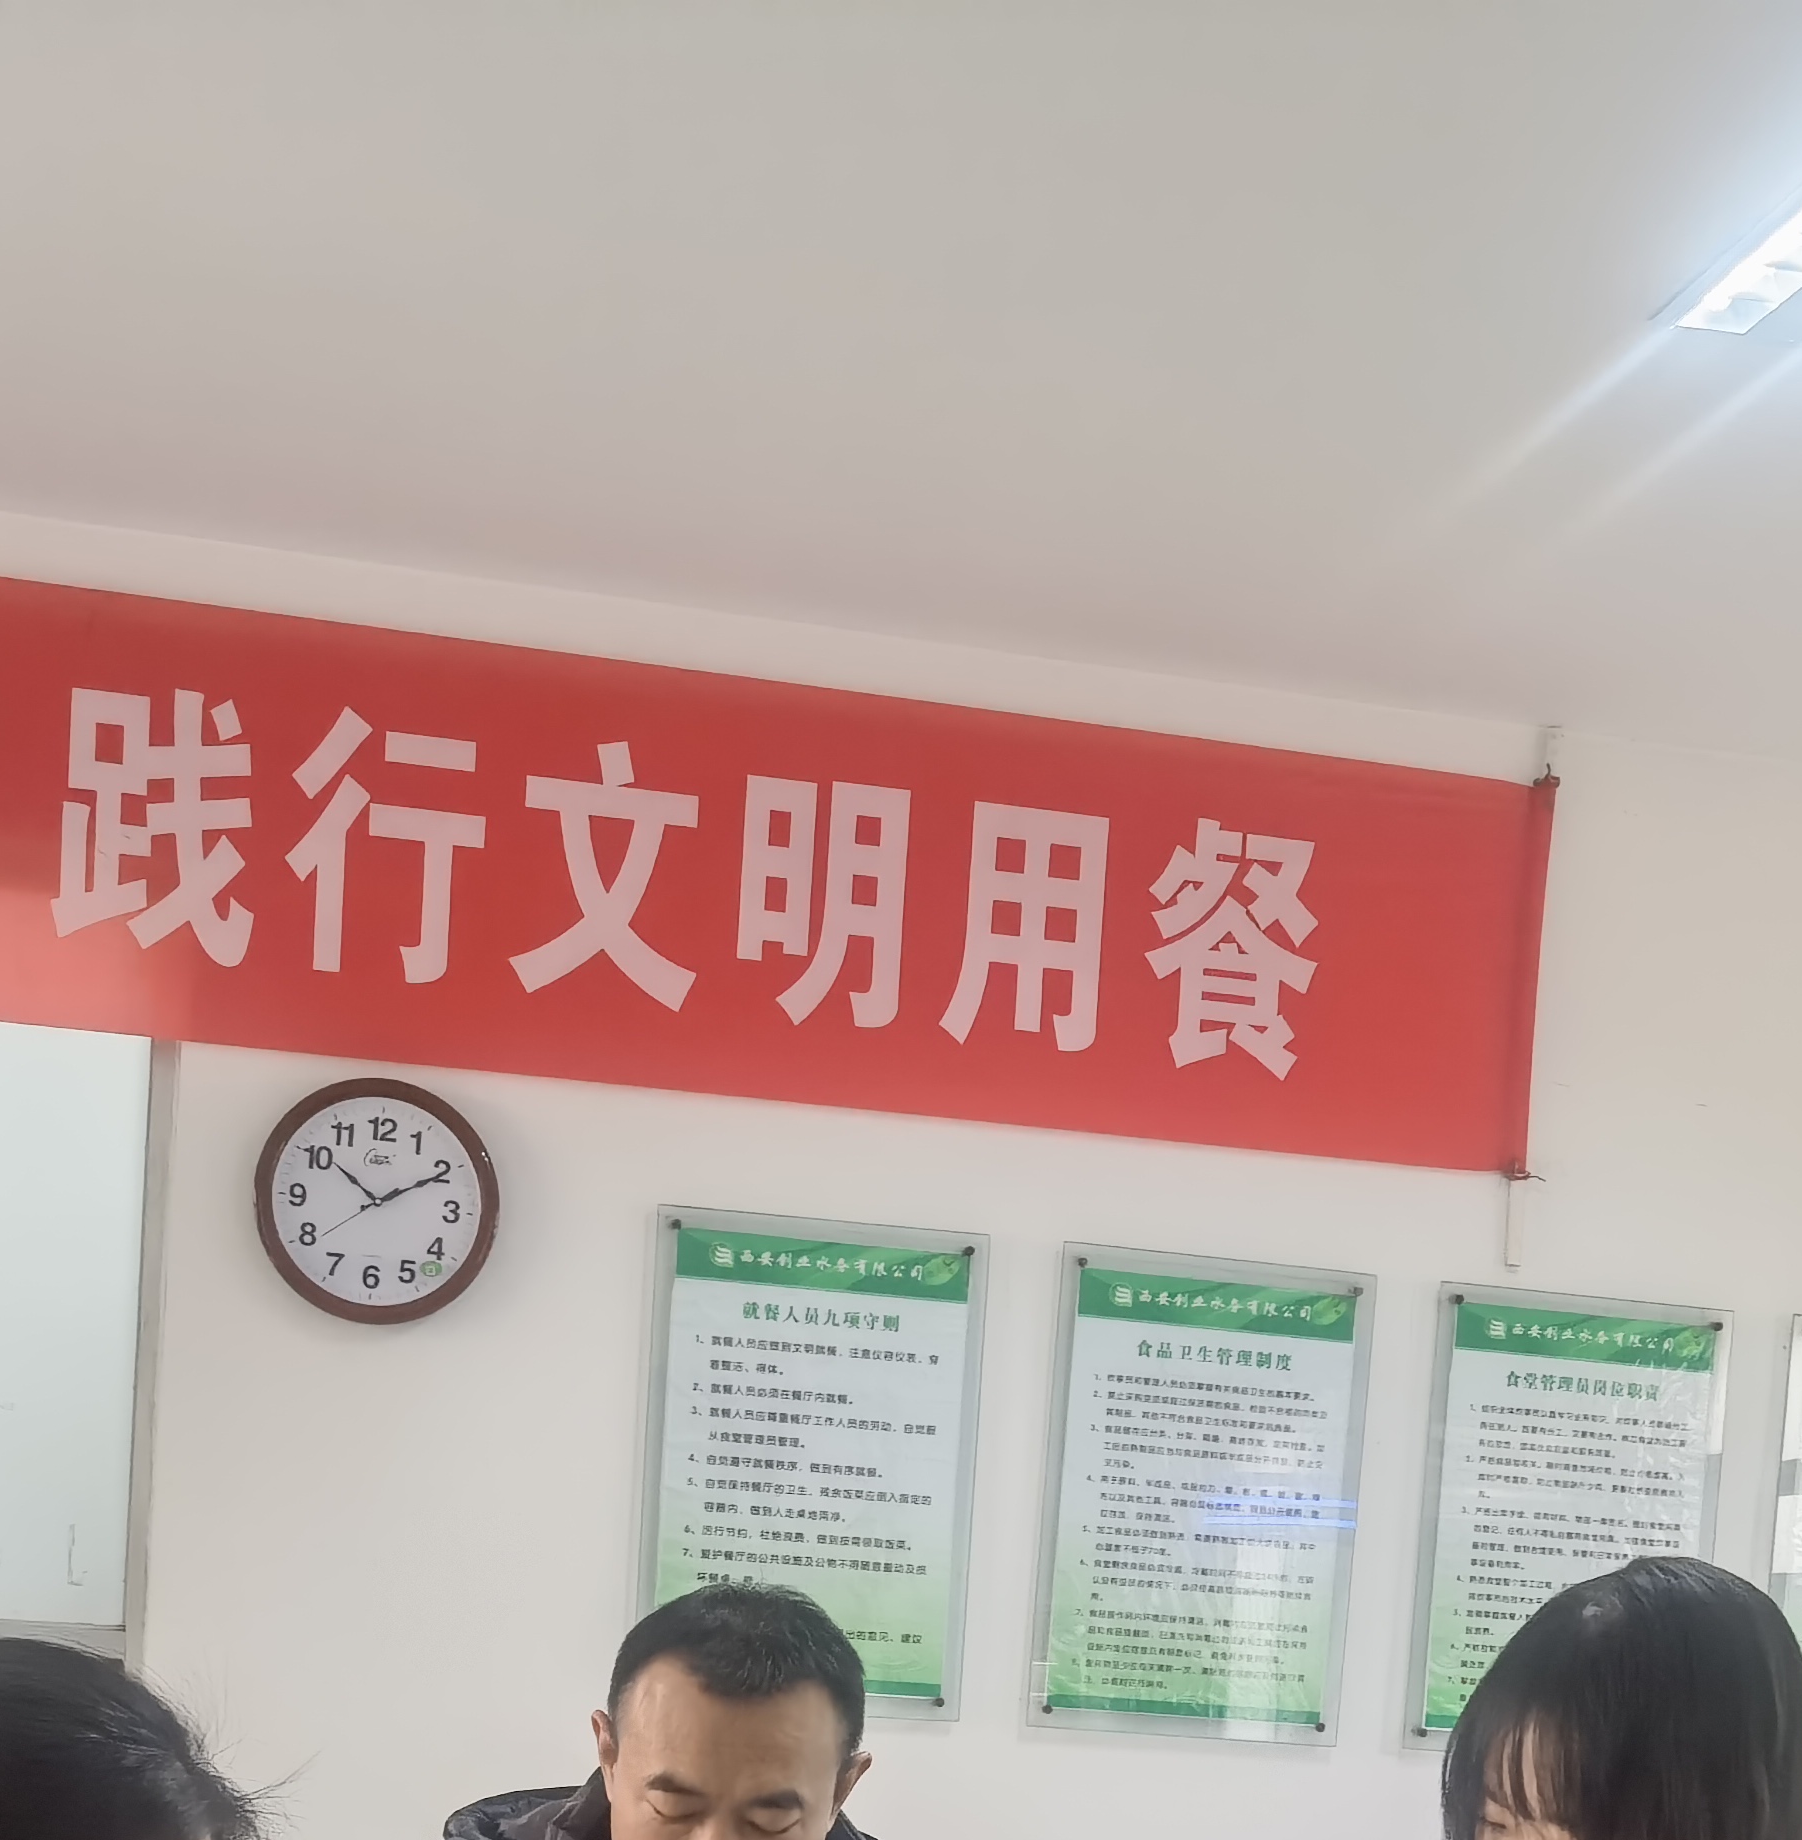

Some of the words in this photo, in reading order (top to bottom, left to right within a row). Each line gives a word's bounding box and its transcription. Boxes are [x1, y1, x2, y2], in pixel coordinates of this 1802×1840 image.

[49, 687, 1321, 1081] 践行文明用餐
[331, 1121, 355, 1148] 11
[367, 1116, 398, 1143] 12
[410, 1131, 423, 1155] 1
[305, 1145, 334, 1170] 10
[432, 1159, 451, 1184] 2
[288, 1183, 307, 1207] 9
[442, 1200, 460, 1224] 3
[298, 1222, 317, 1246] 8
[426, 1237, 445, 1261] 4
[326, 1252, 345, 1276] 7
[398, 1260, 416, 1284] 5
[362, 1265, 381, 1289] 6
[742, 1301, 901, 1334] 就餐人员九项守则
[1136, 1340, 1293, 1372] 食品卫生管理制度
[1506, 1370, 1660, 1402] 食堂管理员岗位职责
